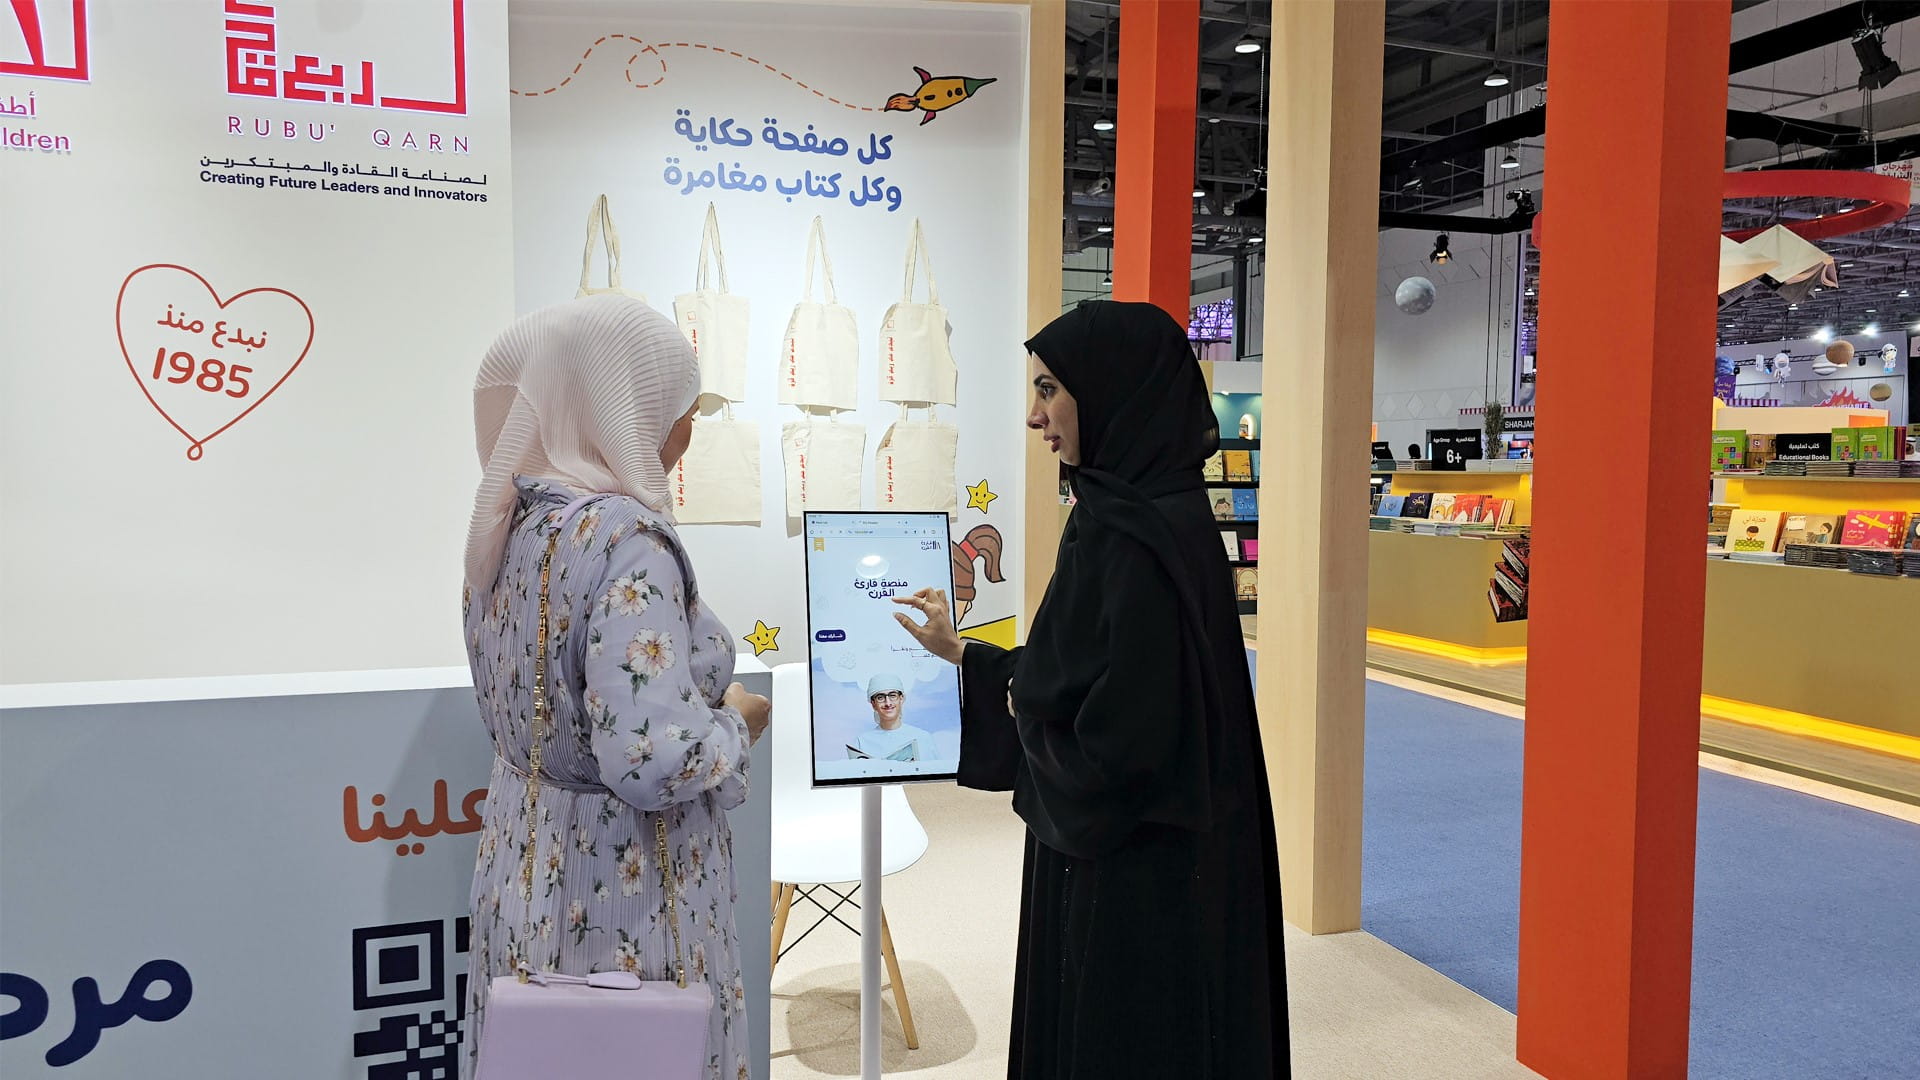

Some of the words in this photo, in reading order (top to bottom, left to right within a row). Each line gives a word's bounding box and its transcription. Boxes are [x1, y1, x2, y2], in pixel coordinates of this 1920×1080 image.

[373, 128, 469, 153] QARN
[674, 108, 753, 152] حكاية
[761, 117, 849, 156] صفحة
[857, 133, 893, 165] كل
[200, 155, 339, 176] والمبتكرين
[342, 163, 398, 178] القادة
[402, 168, 487, 186] لصناعة
[663, 156, 767, 196] مغامرة
[200, 170, 265, 188] Creating
[269, 175, 317, 190] Future
[321, 178, 379, 195] Leaders
[384, 185, 410, 197] and
[414, 186, 488, 203] Innovators
[775, 169, 842, 203] كتاب
[849, 175, 903, 212] وكل
[156, 303, 204, 334] منذ
[211, 320, 268, 353] نبدع
[152, 347, 253, 399] 1985
[1446, 449, 1462, 464] 6+
[1778, 453, 1811, 461] Educational
[854, 578, 878, 590] قارئ
[868, 588, 895, 600] القرن
[881, 578, 908, 589] منصة
